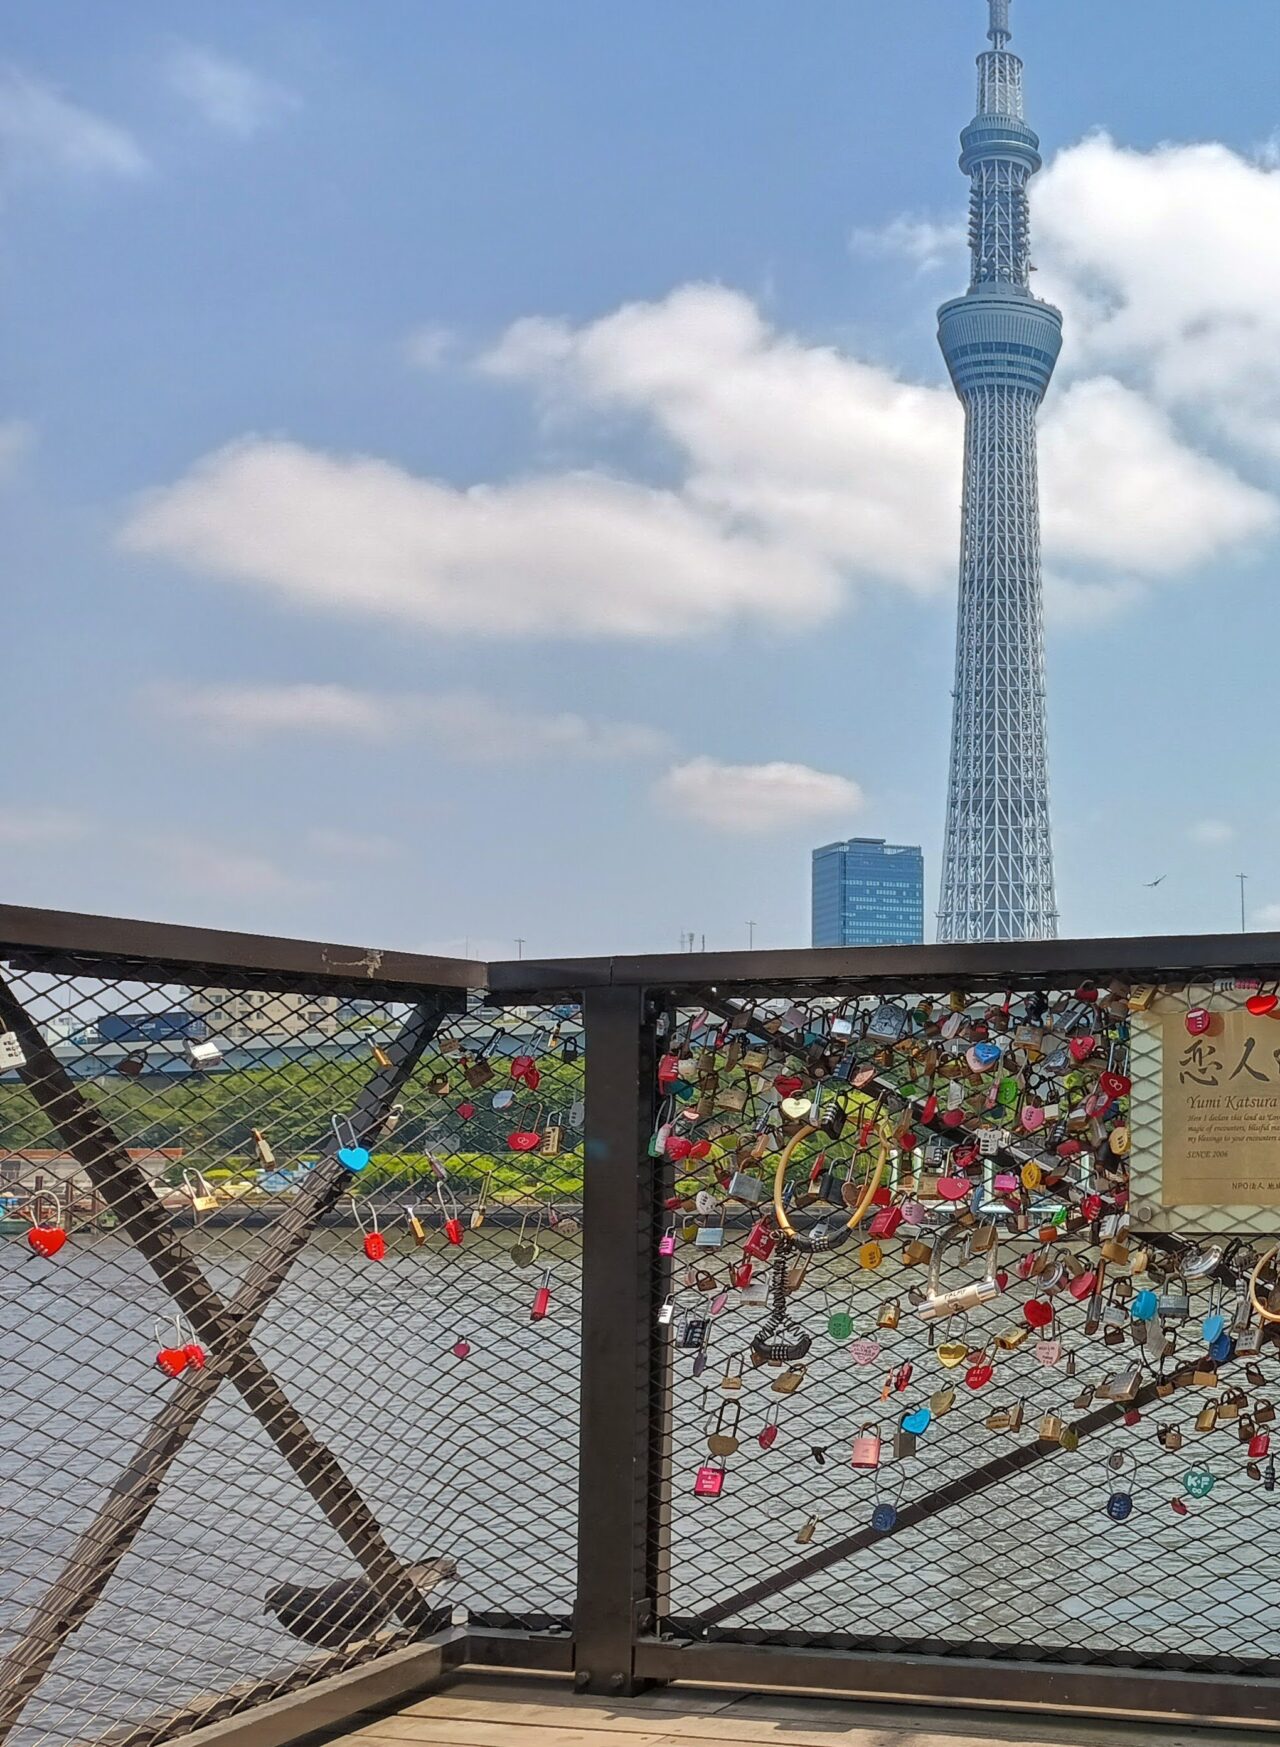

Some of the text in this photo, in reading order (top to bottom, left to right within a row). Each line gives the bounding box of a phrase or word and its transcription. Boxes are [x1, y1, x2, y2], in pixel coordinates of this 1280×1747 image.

[1186, 1094, 1222, 1109] Yumi
[1224, 1095, 1278, 1111] Katsura
[1186, 1151, 1212, 1159] SINCE
